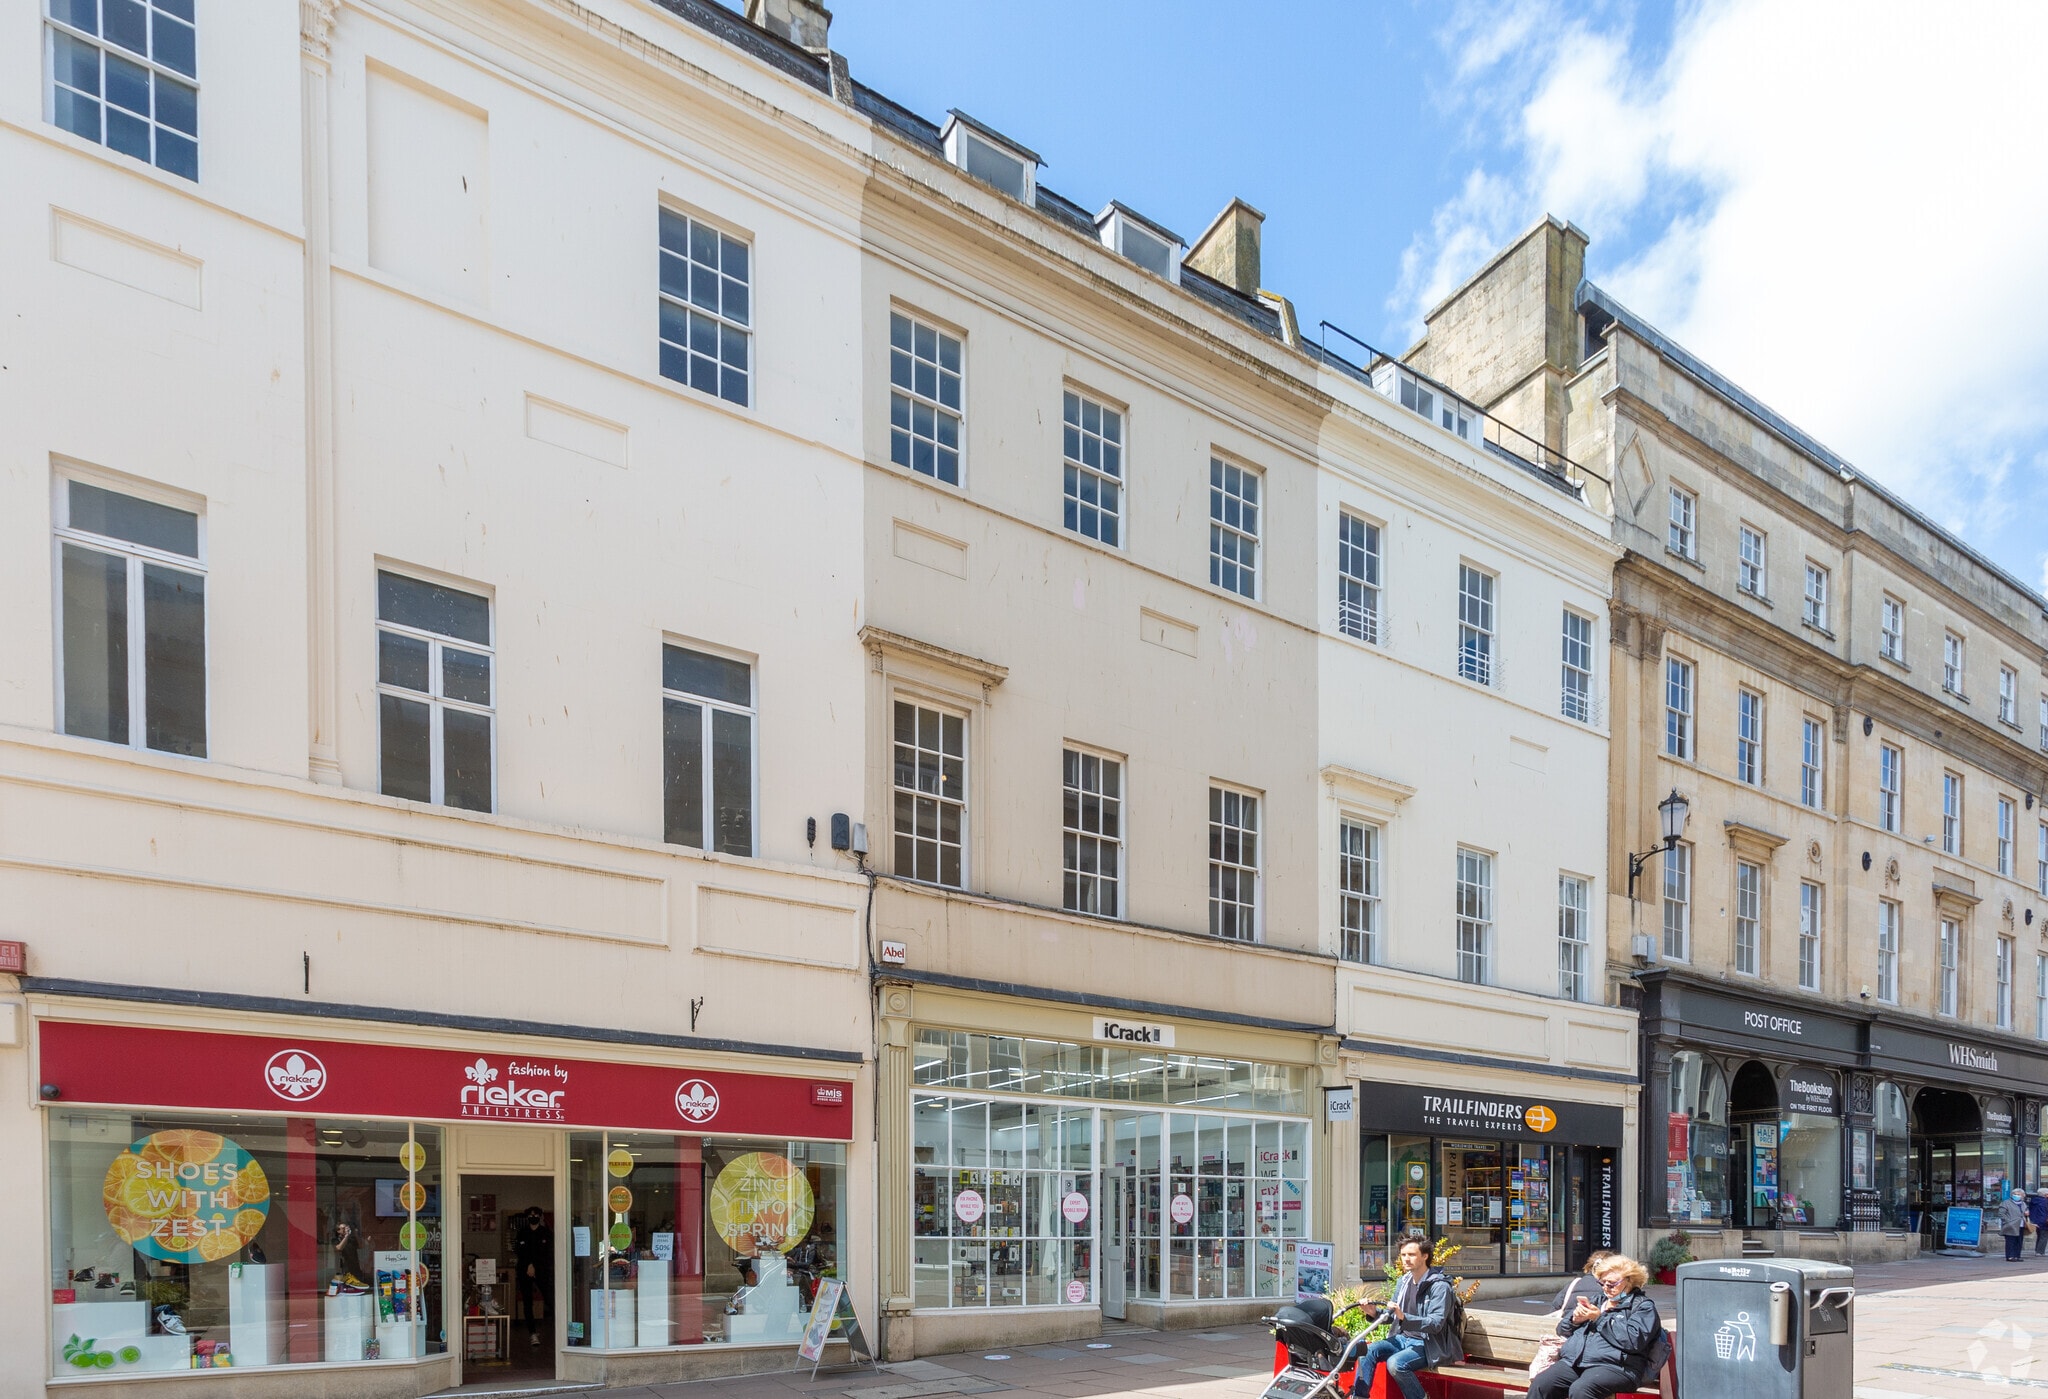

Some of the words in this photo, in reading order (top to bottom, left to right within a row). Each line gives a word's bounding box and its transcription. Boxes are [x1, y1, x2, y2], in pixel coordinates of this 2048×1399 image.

[883, 945, 905, 959] Abel
[1744, 1011, 1769, 1029] POST
[1769, 1016, 1802, 1035] OFFICE
[1104, 1022, 1151, 1043] iCrack
[1948, 1043, 1998, 1072] WHSmith
[279, 1074, 316, 1084] rieker
[508, 1061, 551, 1077] fashion
[554, 1064, 568, 1084] by
[461, 1080, 565, 1108] rieker
[461, 1105, 561, 1119] ANTISTRESS
[685, 1100, 712, 1108] rieker
[1330, 1100, 1351, 1111] iCrack
[1423, 1095, 1522, 1119] TRAILFINDERS
[1789, 1102, 1798, 1110] ON
[1423, 1115, 1441, 1125] THE
[1446, 1117, 1480, 1129] TRAVEL
[1485, 1121, 1523, 1132] EXPERTS
[1757, 1128, 1775, 1136] HALF
[136, 1161, 238, 1180] SHOES
[740, 1178, 786, 1192] ZING
[146, 1190, 228, 1208] WITH
[740, 1199, 786, 1215] INTO
[1602, 1166, 1611, 1248] TRAILFINDERS
[150, 1219, 227, 1237] ZEST
[727, 1223, 799, 1237] SPRING
[1300, 1246, 1322, 1256] iCrack
